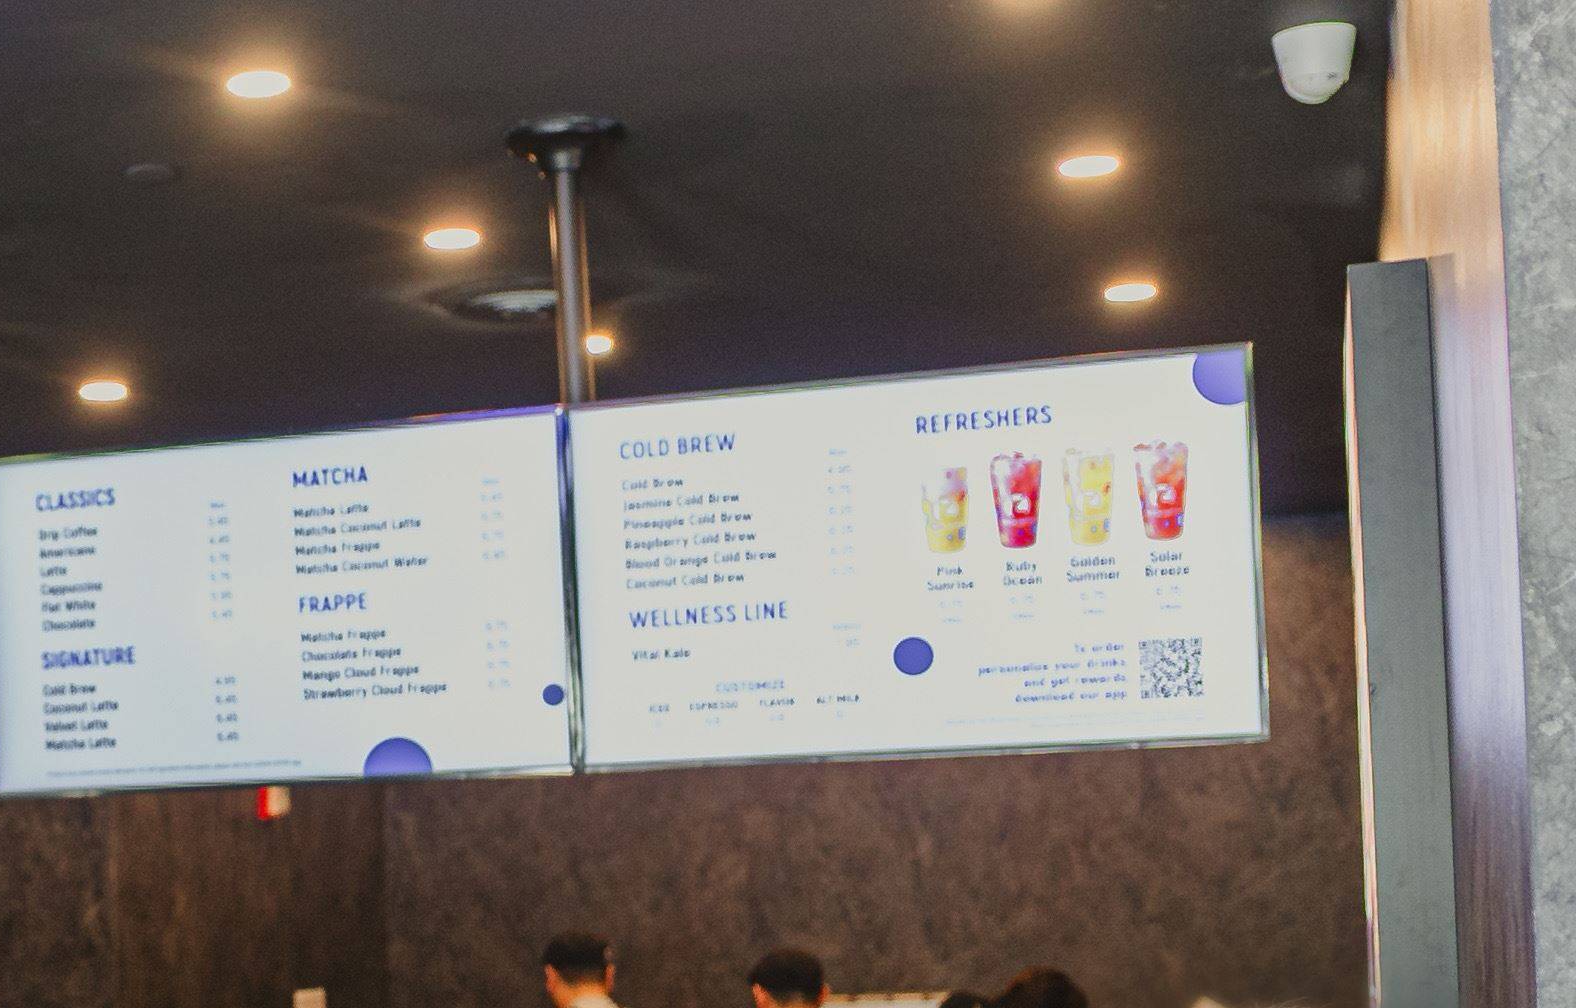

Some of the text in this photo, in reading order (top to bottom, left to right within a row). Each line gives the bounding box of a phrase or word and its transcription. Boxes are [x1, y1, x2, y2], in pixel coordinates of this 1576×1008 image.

[915, 405, 1052, 434] REFRESHERS
[619, 432, 736, 460] COLD BREW
[292, 465, 369, 488] MATCHA
[622, 477, 684, 491] Cold Brew
[35, 487, 115, 512] CLASSICS
[624, 493, 740, 511] Jasmine Cold Brew
[293, 504, 369, 518] Matcha Latte
[294, 518, 421, 537] Matcha Coconut Latte
[624, 512, 752, 530] Pineapple Cold Brew
[63, 526, 98, 539] Coffee
[295, 540, 380, 556] Matcha Frappe
[625, 532, 756, 550] Raspberry Cold Brew
[40, 546, 97, 559] Americano
[625, 550, 777, 570] Blood Orange Cold Brew
[1150, 551, 1184, 563] Solar
[296, 556, 427, 575] Matcha Coconut Water
[1006, 560, 1037, 574] Ruby
[1070, 556, 1116, 568] Golden
[40, 565, 67, 577] Latte
[936, 565, 963, 577] Pink
[1067, 570, 1120, 583] Summer
[1145, 565, 1190, 578] Breeze
[626, 572, 744, 590] Coconut Cold Brew
[927, 579, 974, 592] Sunrise
[1003, 574, 1043, 587] Ocean
[40, 582, 103, 596] Cappuccino
[65, 600, 96, 611] White
[299, 592, 367, 613] FRAPPE
[628, 600, 788, 629] WELLNESS LINE
[42, 619, 96, 632] Chocolate
[300, 628, 386, 643] Matcha Frappe
[42, 645, 136, 670] SIGNATURE
[302, 647, 401, 663] Chocolate Frappe
[631, 647, 691, 661] Vital Kale
[302, 665, 419, 683] Mango Cloud Frappe
[978, 662, 1048, 677] personalize
[1055, 661, 1080, 674] your
[42, 682, 96, 697] Cold Brew
[716, 679, 785, 692] CUSTOMIZE
[1024, 677, 1046, 688] and
[1052, 676, 1070, 690] get
[304, 682, 447, 700] Strawberry Cloud Frappe
[1015, 689, 1127, 703] download our app
[44, 700, 119, 715] Coconut Latte
[45, 718, 108, 733] Velvet Latte
[45, 737, 117, 751] Matcha Latte
